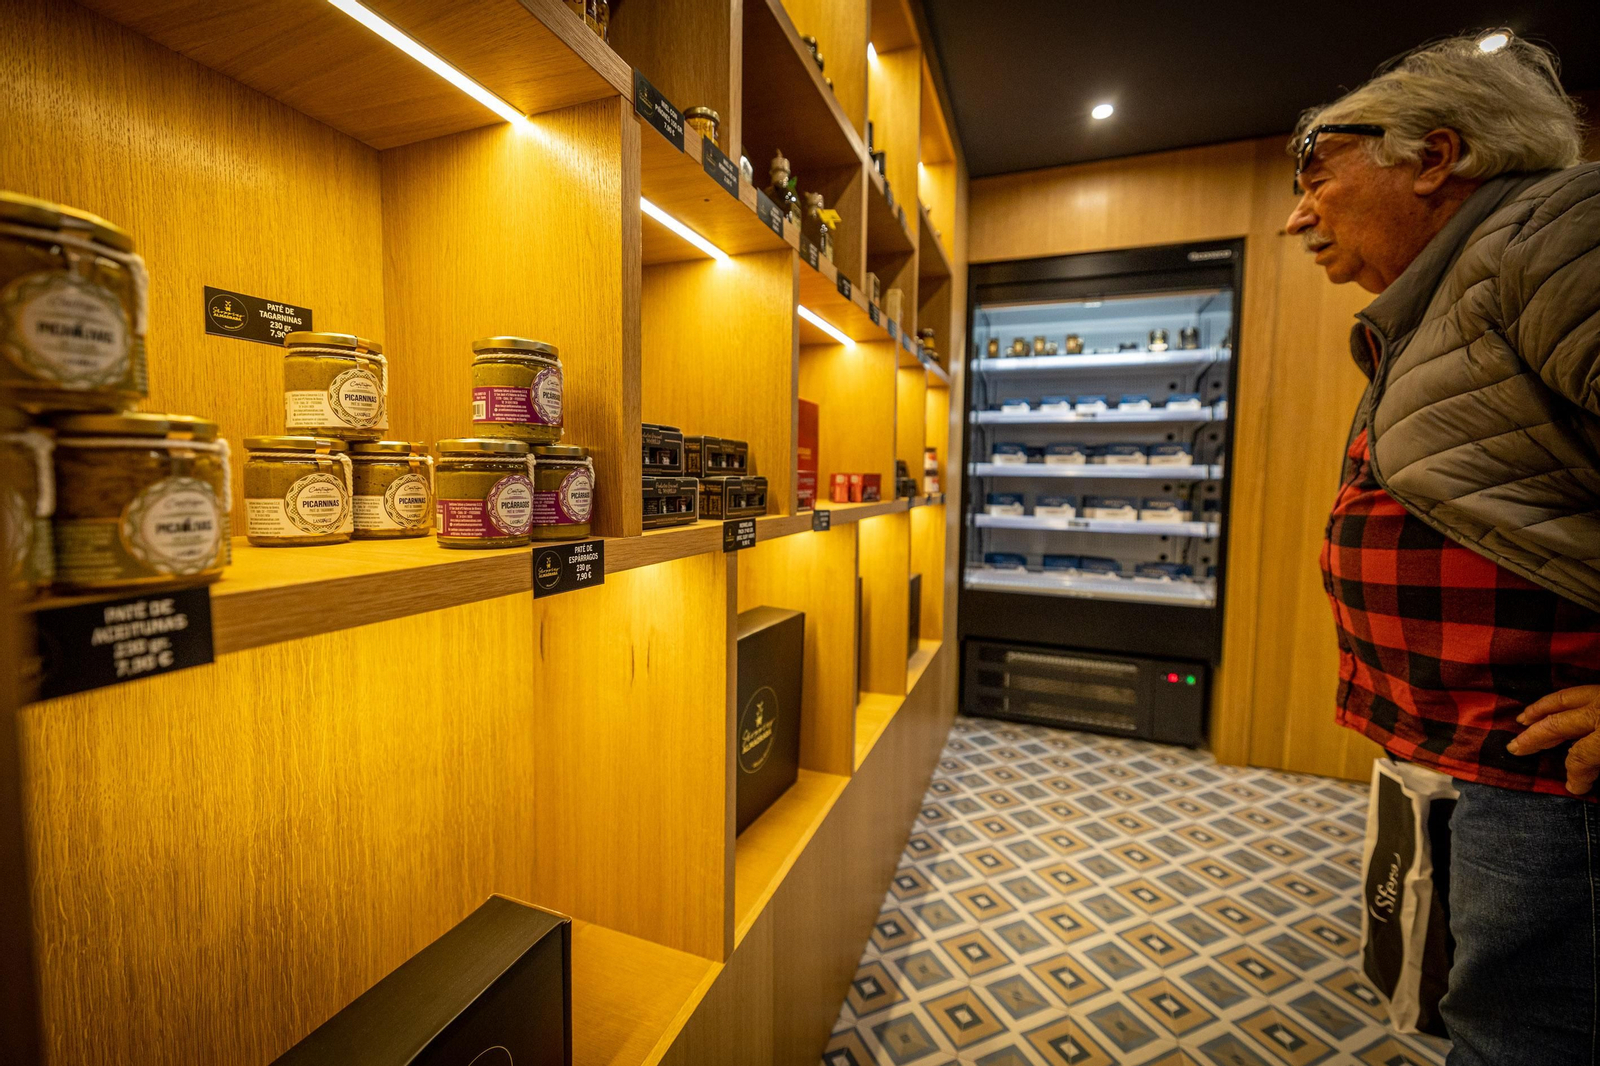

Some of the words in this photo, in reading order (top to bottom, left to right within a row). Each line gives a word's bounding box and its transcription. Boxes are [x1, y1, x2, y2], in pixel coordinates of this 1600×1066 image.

[267, 303, 284, 313] PATÉ
[286, 307, 294, 316] DE
[259, 310, 302, 325] TAGARNINAS
[270, 321, 282, 330] 230
[344, 393, 377, 404] PICARNINAS
[302, 500, 340, 508] PICARNINAS
[501, 500, 530, 510] PICÁRRAGOS
[574, 544, 586, 554] PATÉ
[568, 553, 598, 564] ESPÁRRAGOS
[576, 564, 585, 572] 230
[577, 572, 587, 582] 7,90
[149, 598, 175, 618] DE
[91, 613, 188, 647] ACEITUNAS
[158, 650, 174, 668] €
